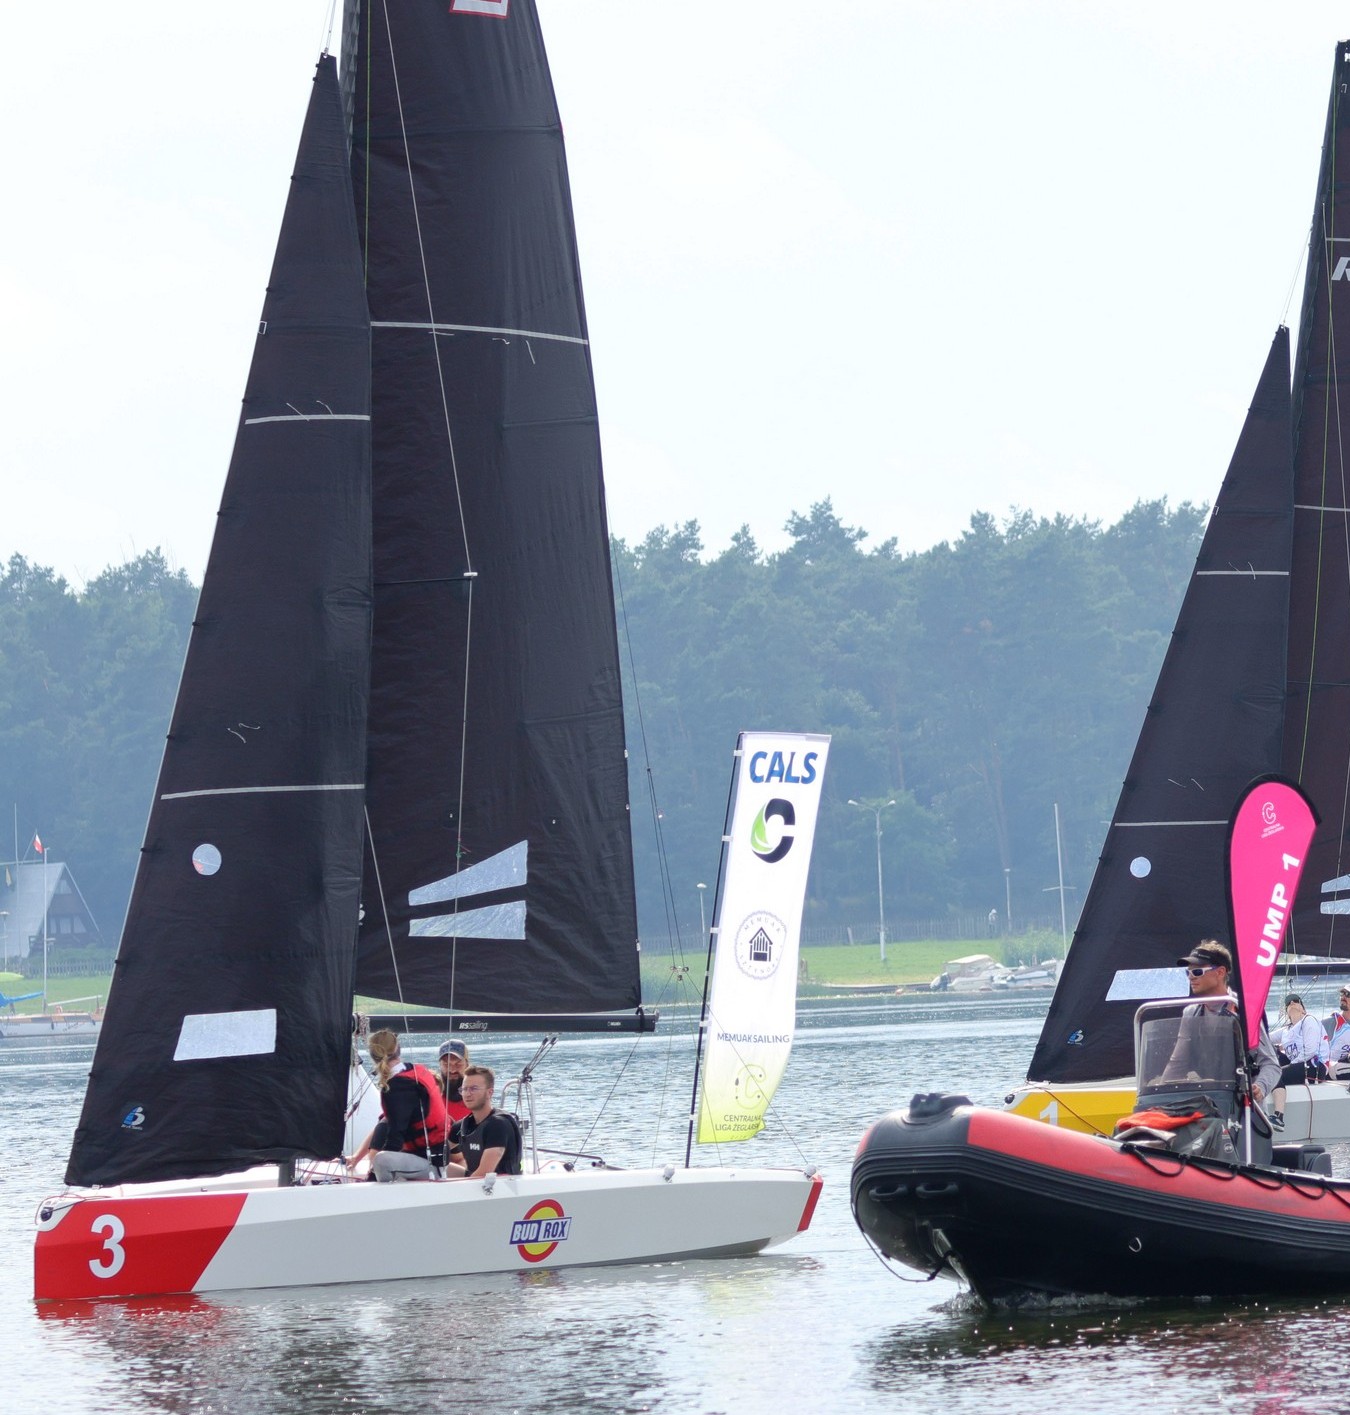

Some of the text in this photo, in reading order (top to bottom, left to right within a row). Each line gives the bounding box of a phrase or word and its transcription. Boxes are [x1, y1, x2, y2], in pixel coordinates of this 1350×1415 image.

[749, 750, 819, 785] CALS
[1256, 851, 1301, 968] UMP 1
[753, 1034, 790, 1044] SAILING
[88, 1213, 126, 1279] 3
[511, 1220, 568, 1242] BUD ROX
